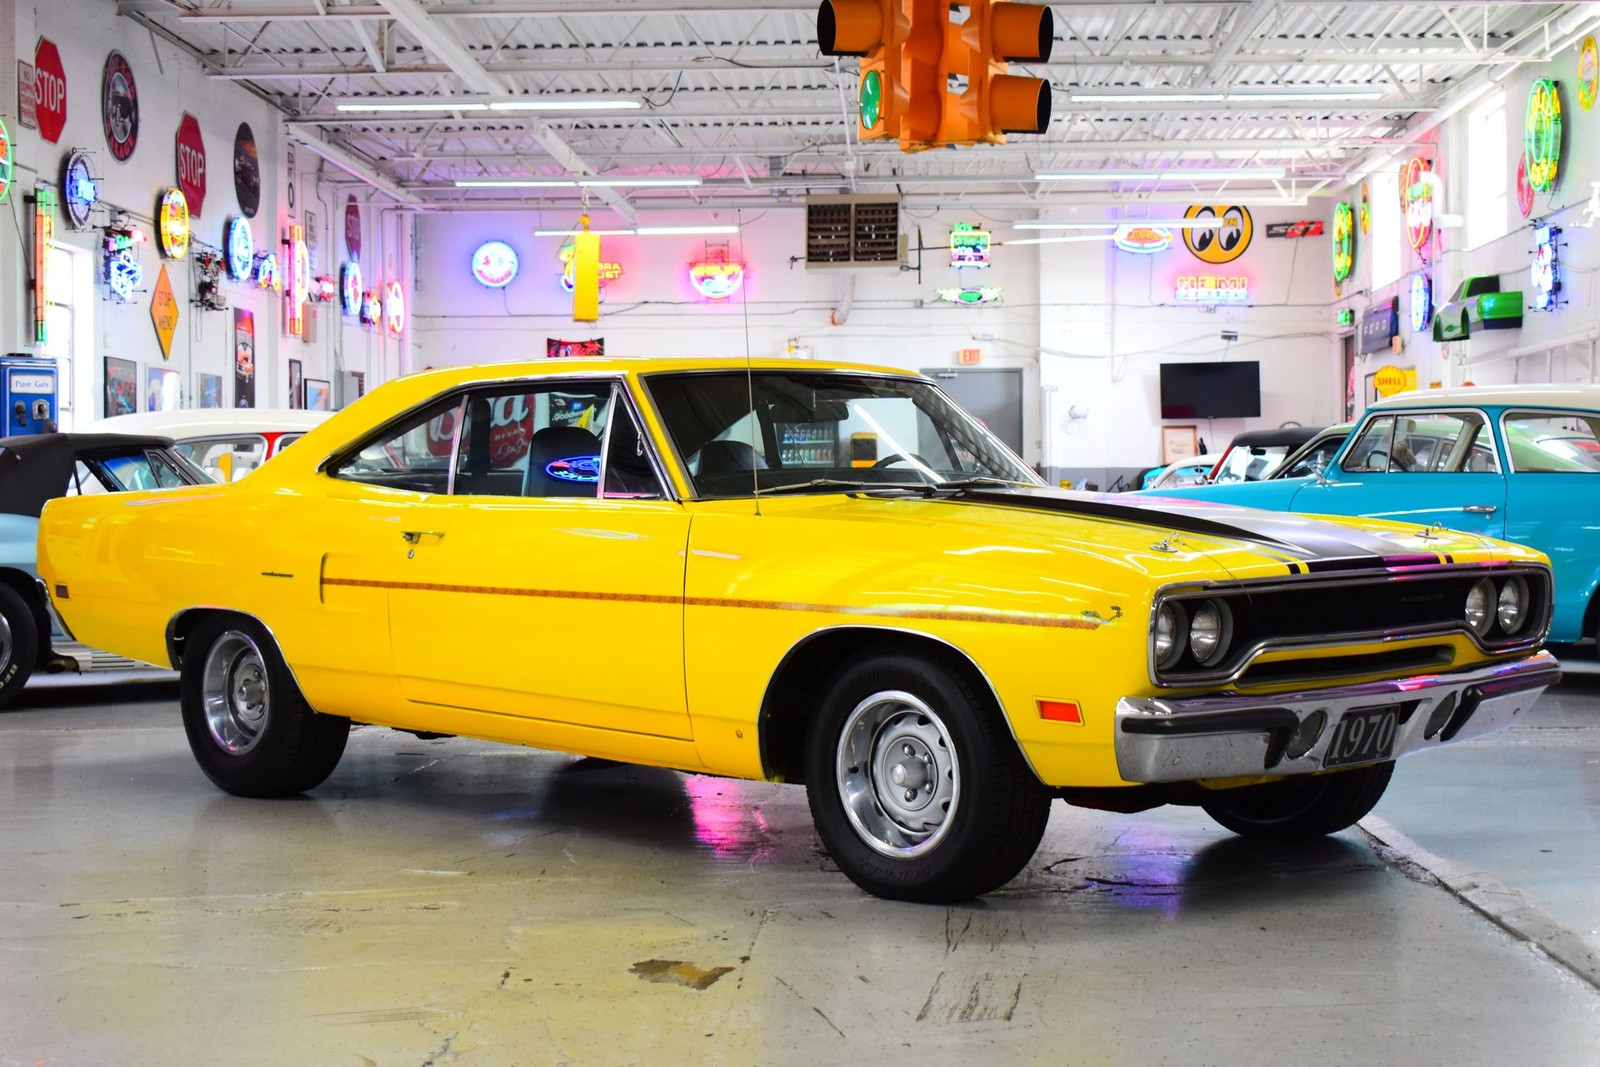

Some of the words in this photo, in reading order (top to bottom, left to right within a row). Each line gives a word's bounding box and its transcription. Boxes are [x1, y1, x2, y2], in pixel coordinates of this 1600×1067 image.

[35, 67, 65, 114] STOP
[180, 142, 205, 188] STOP
[1177, 276, 1248, 290] HEMI
[963, 349, 980, 363] EXIT
[15, 380, 32, 388] Pure
[34, 380, 50, 388] Gas
[1377, 377, 1402, 386] SHELL
[1329, 712, 1396, 759] 1970
